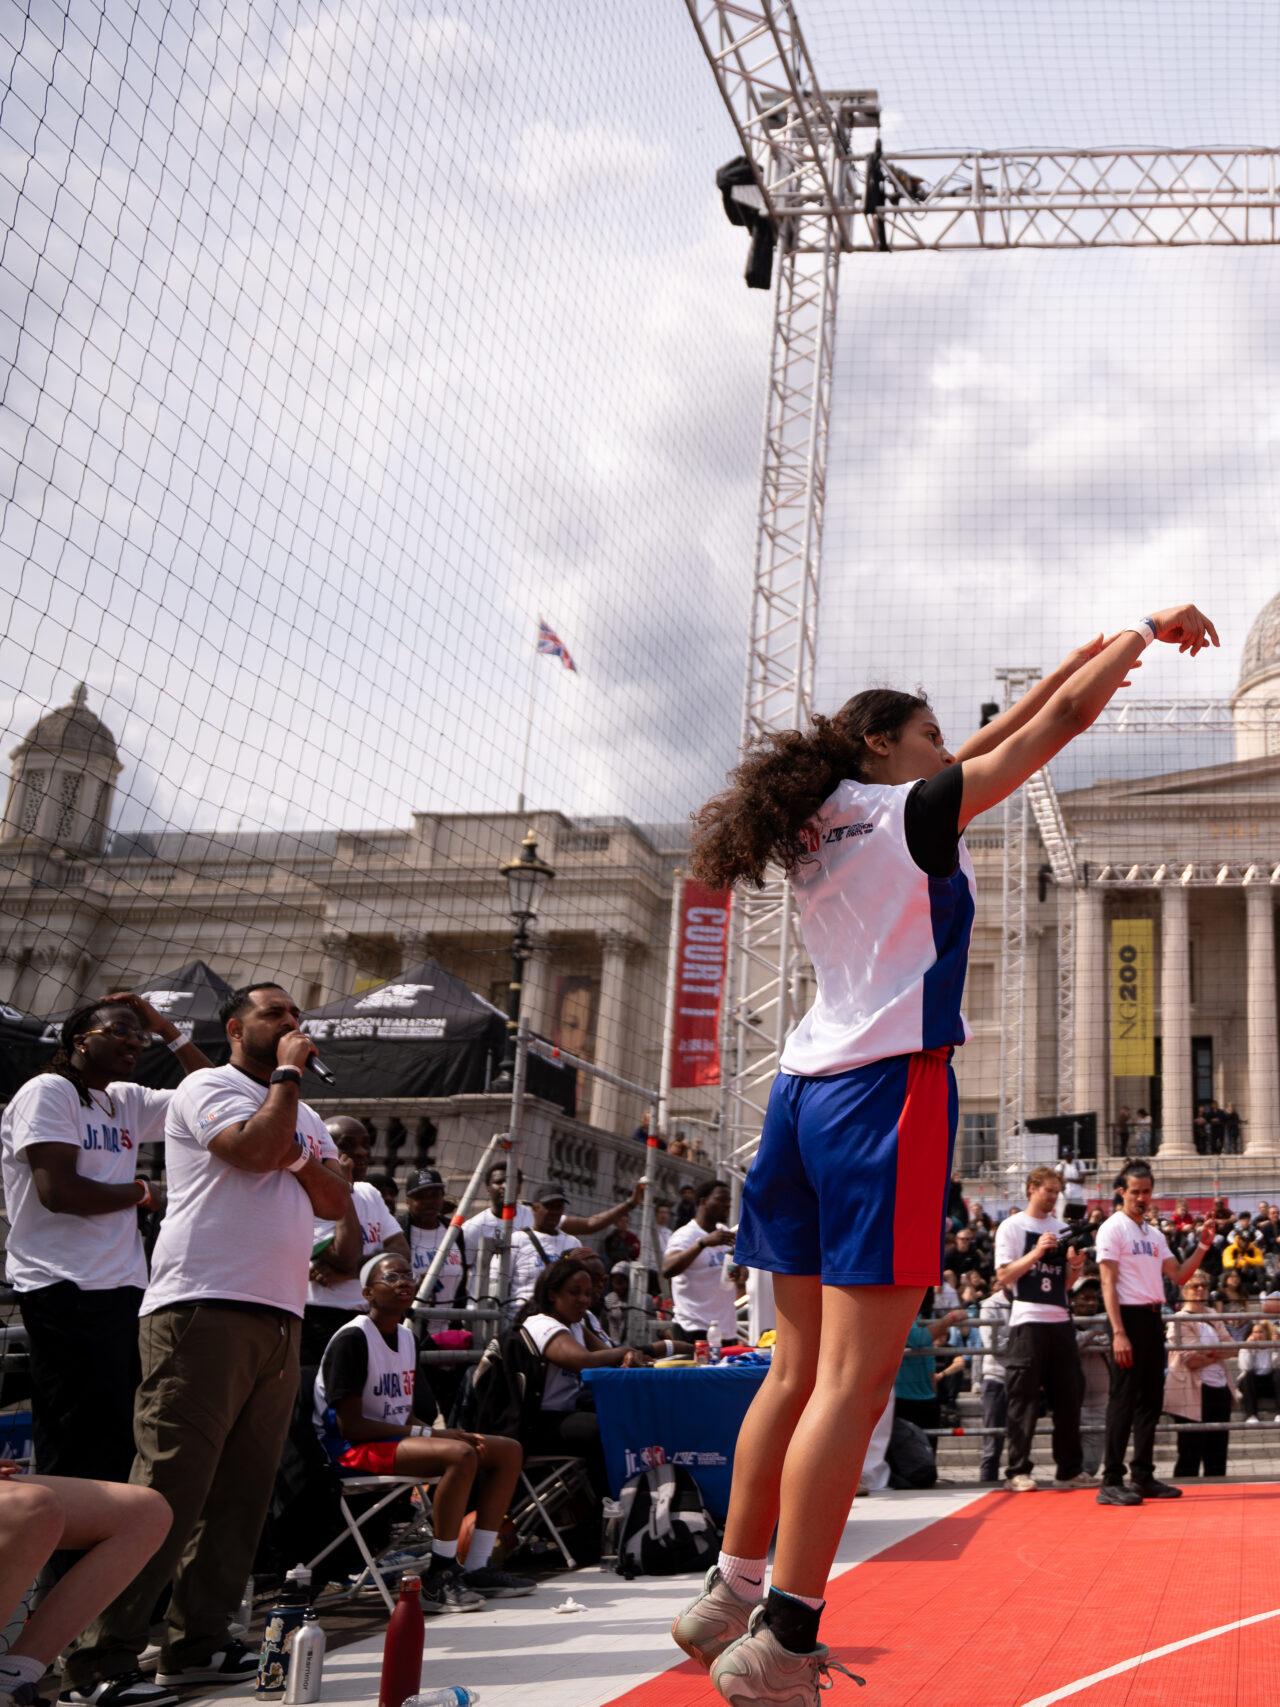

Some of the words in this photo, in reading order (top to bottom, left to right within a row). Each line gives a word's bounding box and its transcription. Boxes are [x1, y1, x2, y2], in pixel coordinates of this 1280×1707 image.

[681, 906, 727, 997] COURT
[1118, 945, 1138, 1040] NG200
[1041, 1277, 1052, 1292] 8
